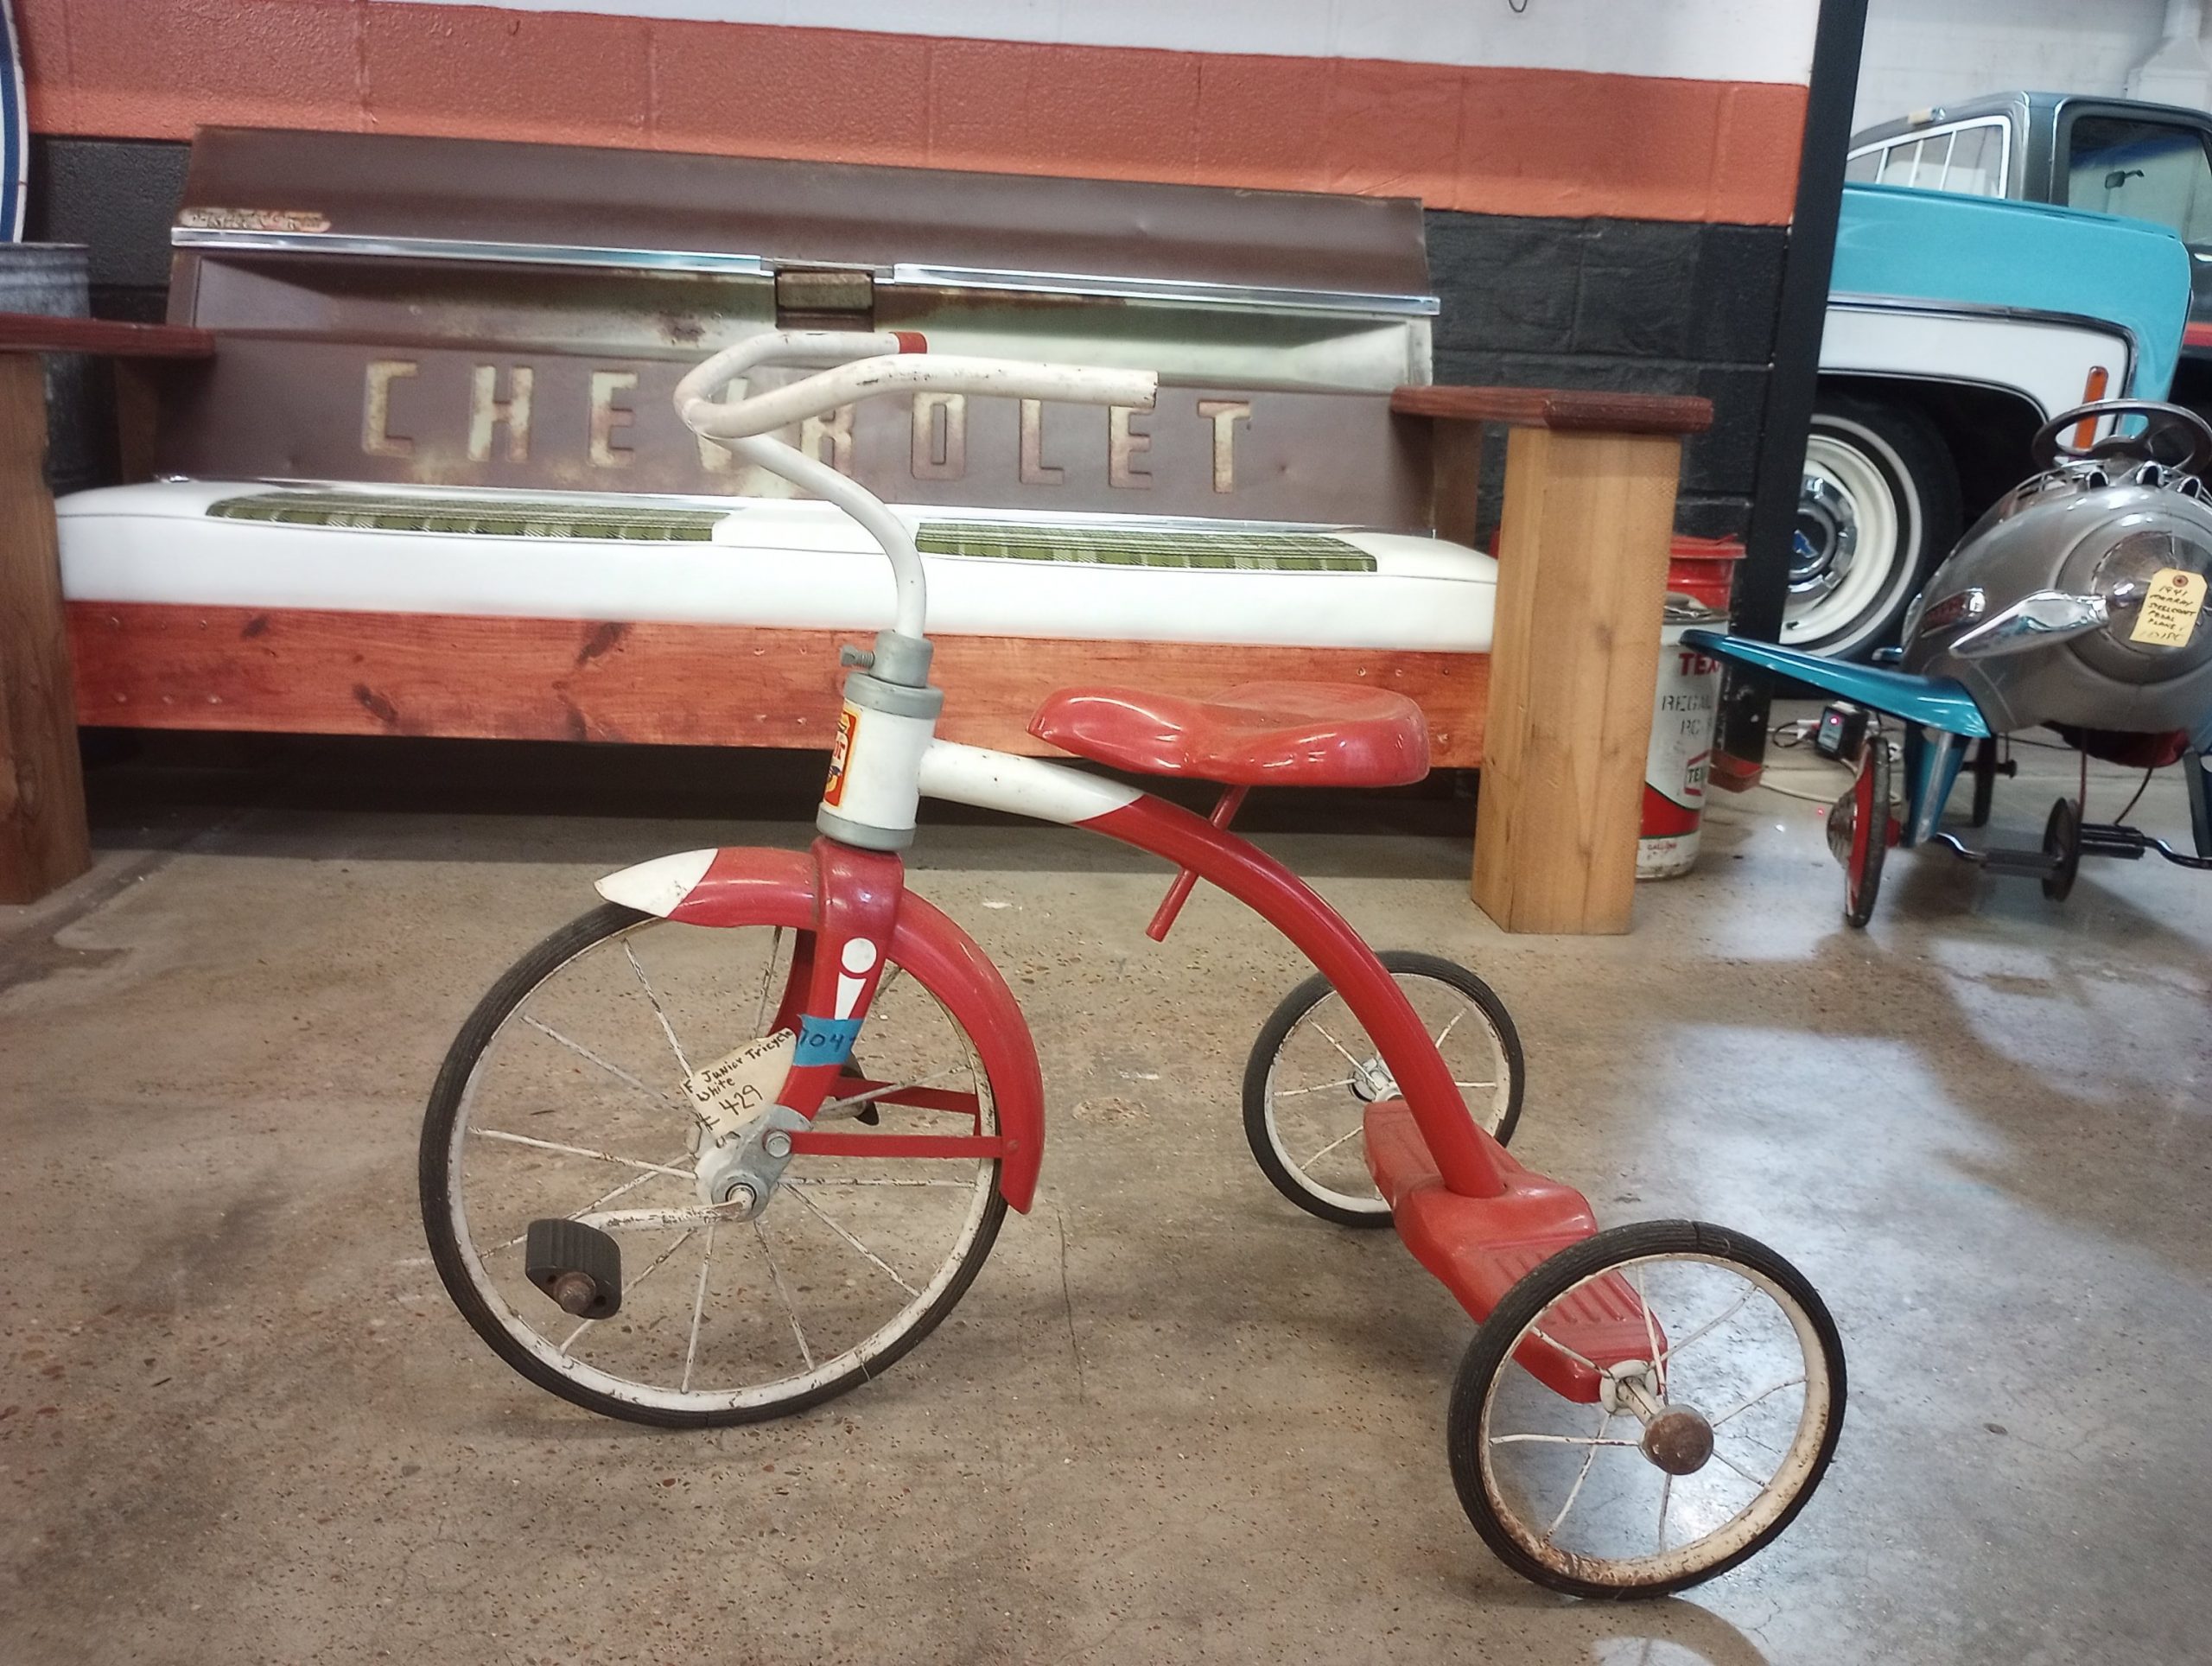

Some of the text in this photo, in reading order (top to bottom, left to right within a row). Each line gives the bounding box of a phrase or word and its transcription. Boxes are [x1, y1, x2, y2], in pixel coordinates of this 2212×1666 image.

[2158, 586, 2189, 598] 1941
[701, 1056, 744, 1084] Junior
[744, 1029, 795, 1061] Tricycle
[696, 1076, 737, 1103] White
[718, 1084, 764, 1116] 429
